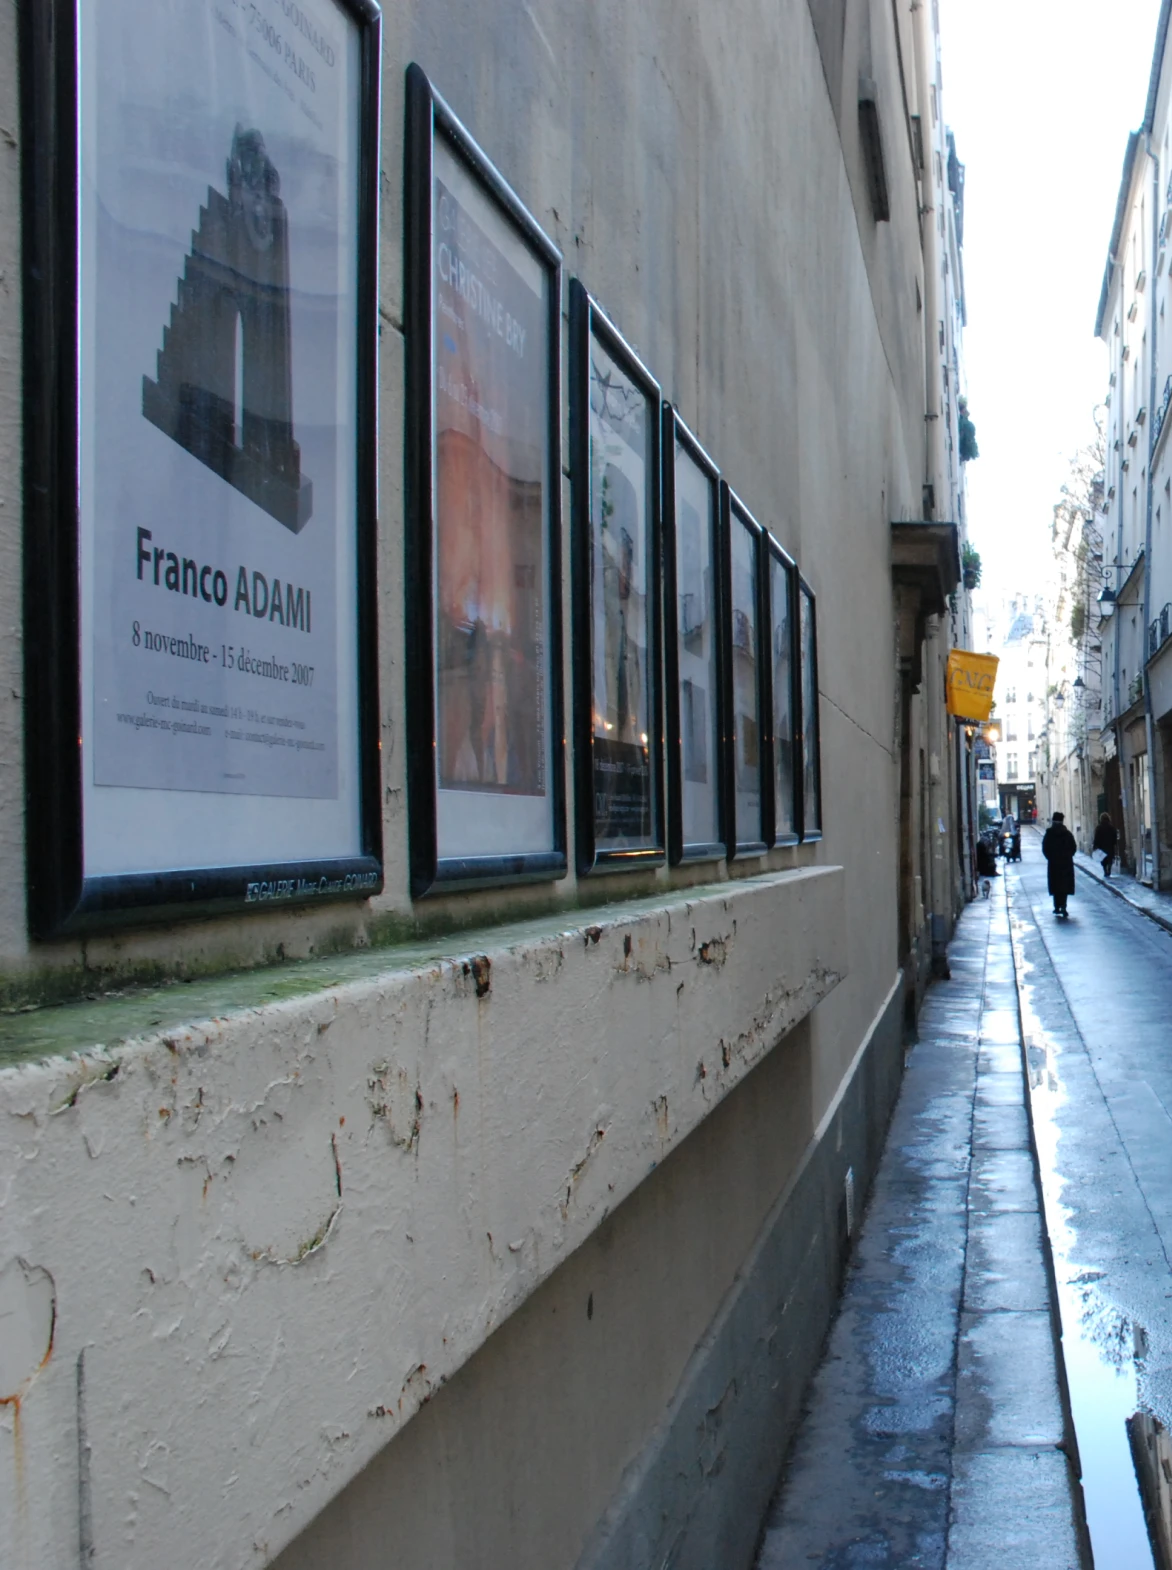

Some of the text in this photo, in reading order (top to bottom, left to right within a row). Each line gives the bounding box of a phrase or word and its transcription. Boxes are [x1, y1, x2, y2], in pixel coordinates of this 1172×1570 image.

[283, 41, 316, 93] PARIS
[439, 242, 506, 337] CHRISTINE
[505, 312, 526, 359] BRY
[137, 526, 312, 634] Franco ADAMI
[132, 620, 141, 647] 8
[144, 630, 210, 664] novembre
[221, 644, 235, 669] 15
[238, 647, 290, 682] décembre
[292, 662, 315, 688] 2007
[147, 690, 170, 709] Ouvert
[258, 880, 294, 901] GALERIE
